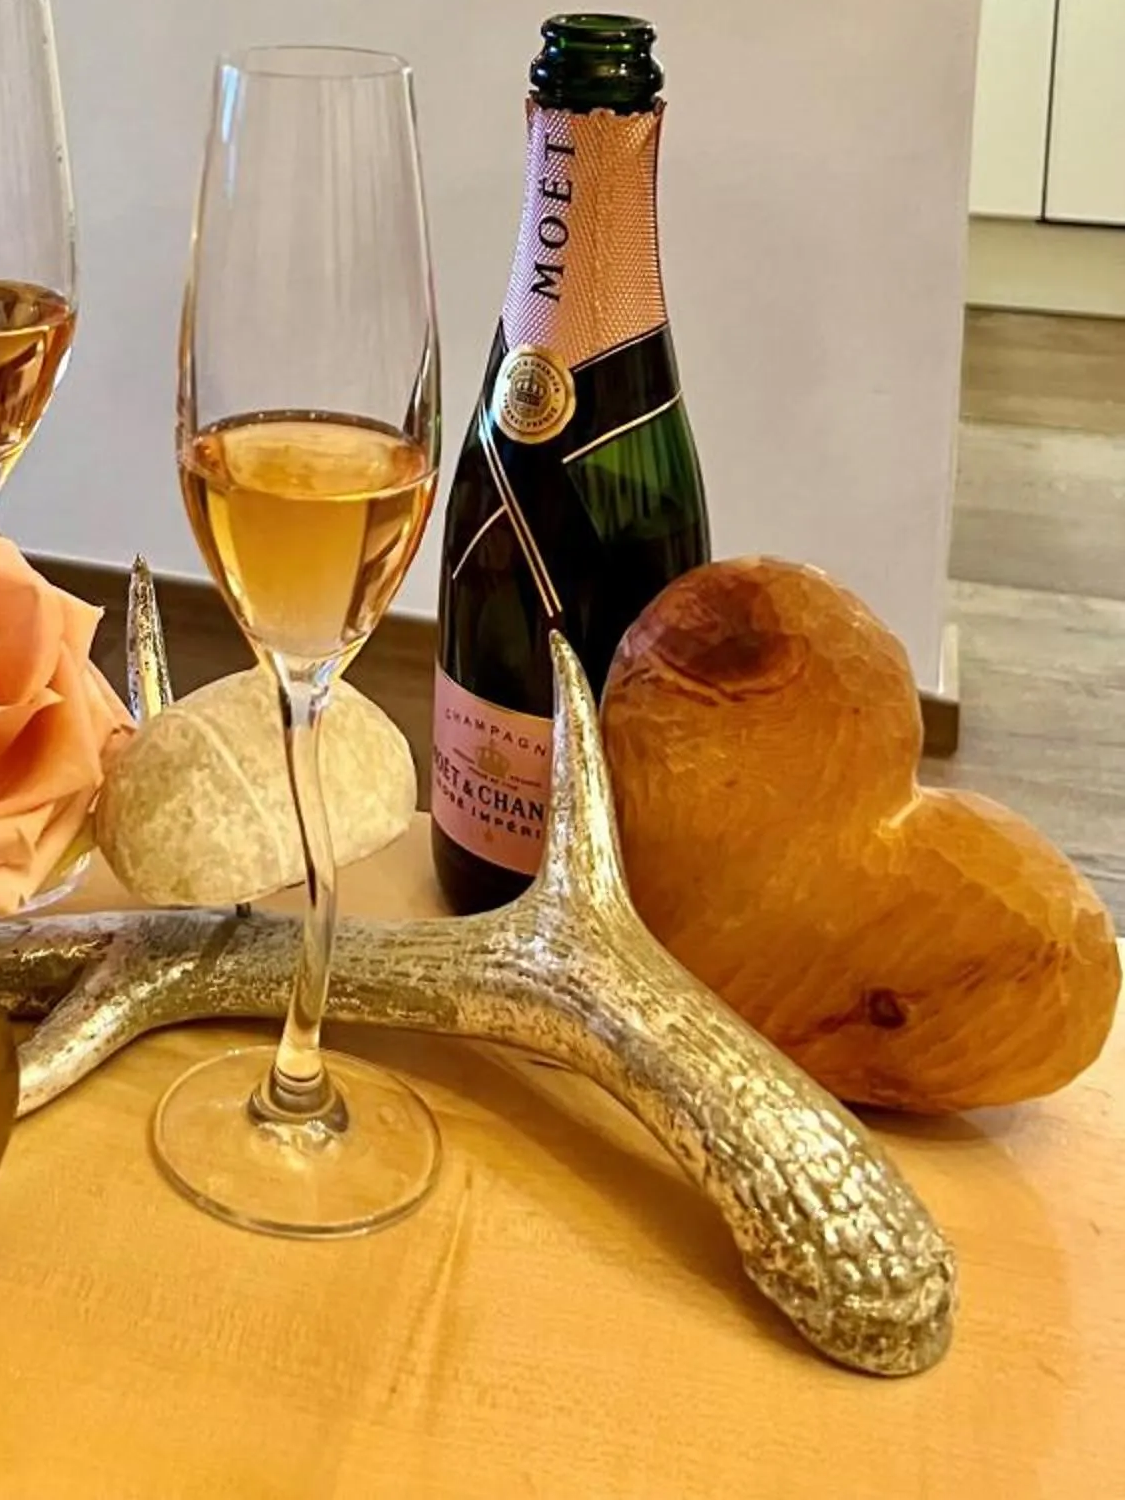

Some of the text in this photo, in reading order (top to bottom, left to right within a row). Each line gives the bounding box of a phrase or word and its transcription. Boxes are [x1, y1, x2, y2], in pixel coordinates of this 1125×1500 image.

[531, 135, 576, 301] MOËT
[445, 707, 547, 757] CHAMPAGN
[472, 807, 542, 840] IMPÉRI
[478, 785, 544, 822] CHAN
